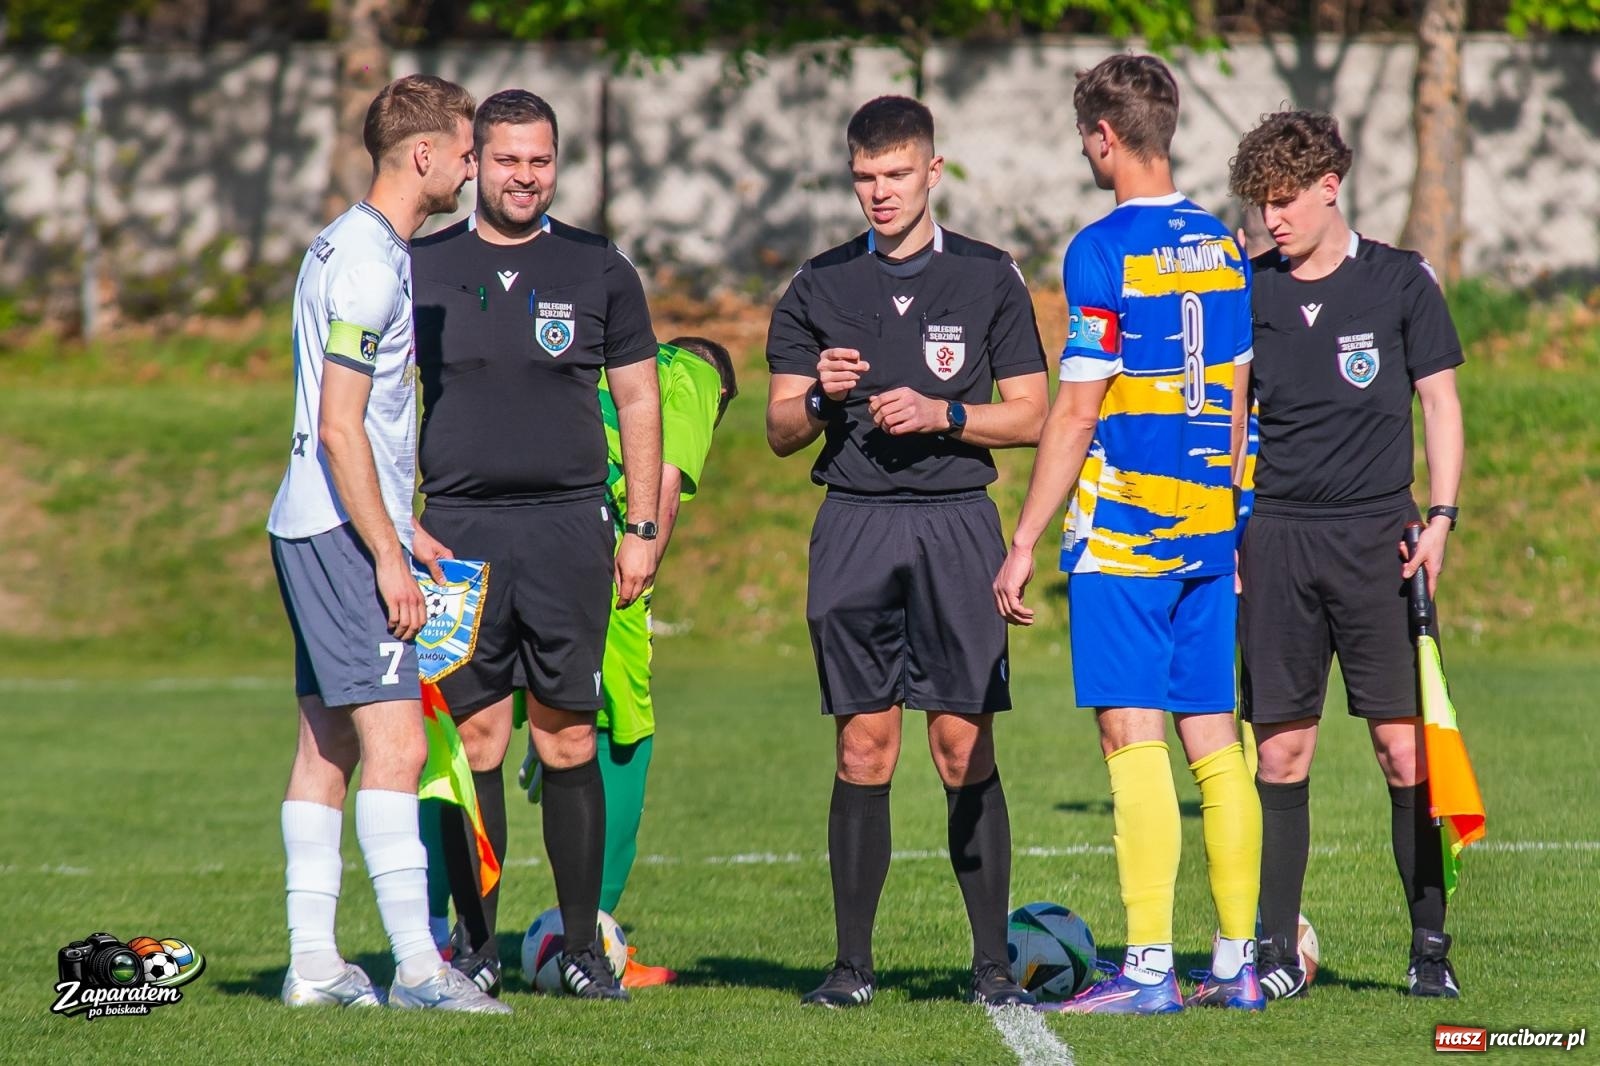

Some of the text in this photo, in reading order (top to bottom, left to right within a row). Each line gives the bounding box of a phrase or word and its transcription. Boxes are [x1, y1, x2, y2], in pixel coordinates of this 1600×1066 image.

[538, 302, 573, 311] KOLEGIUM
[928, 325, 963, 334] KOLEGIUM
[1181, 291, 1205, 417] 8
[379, 641, 404, 685] 7
